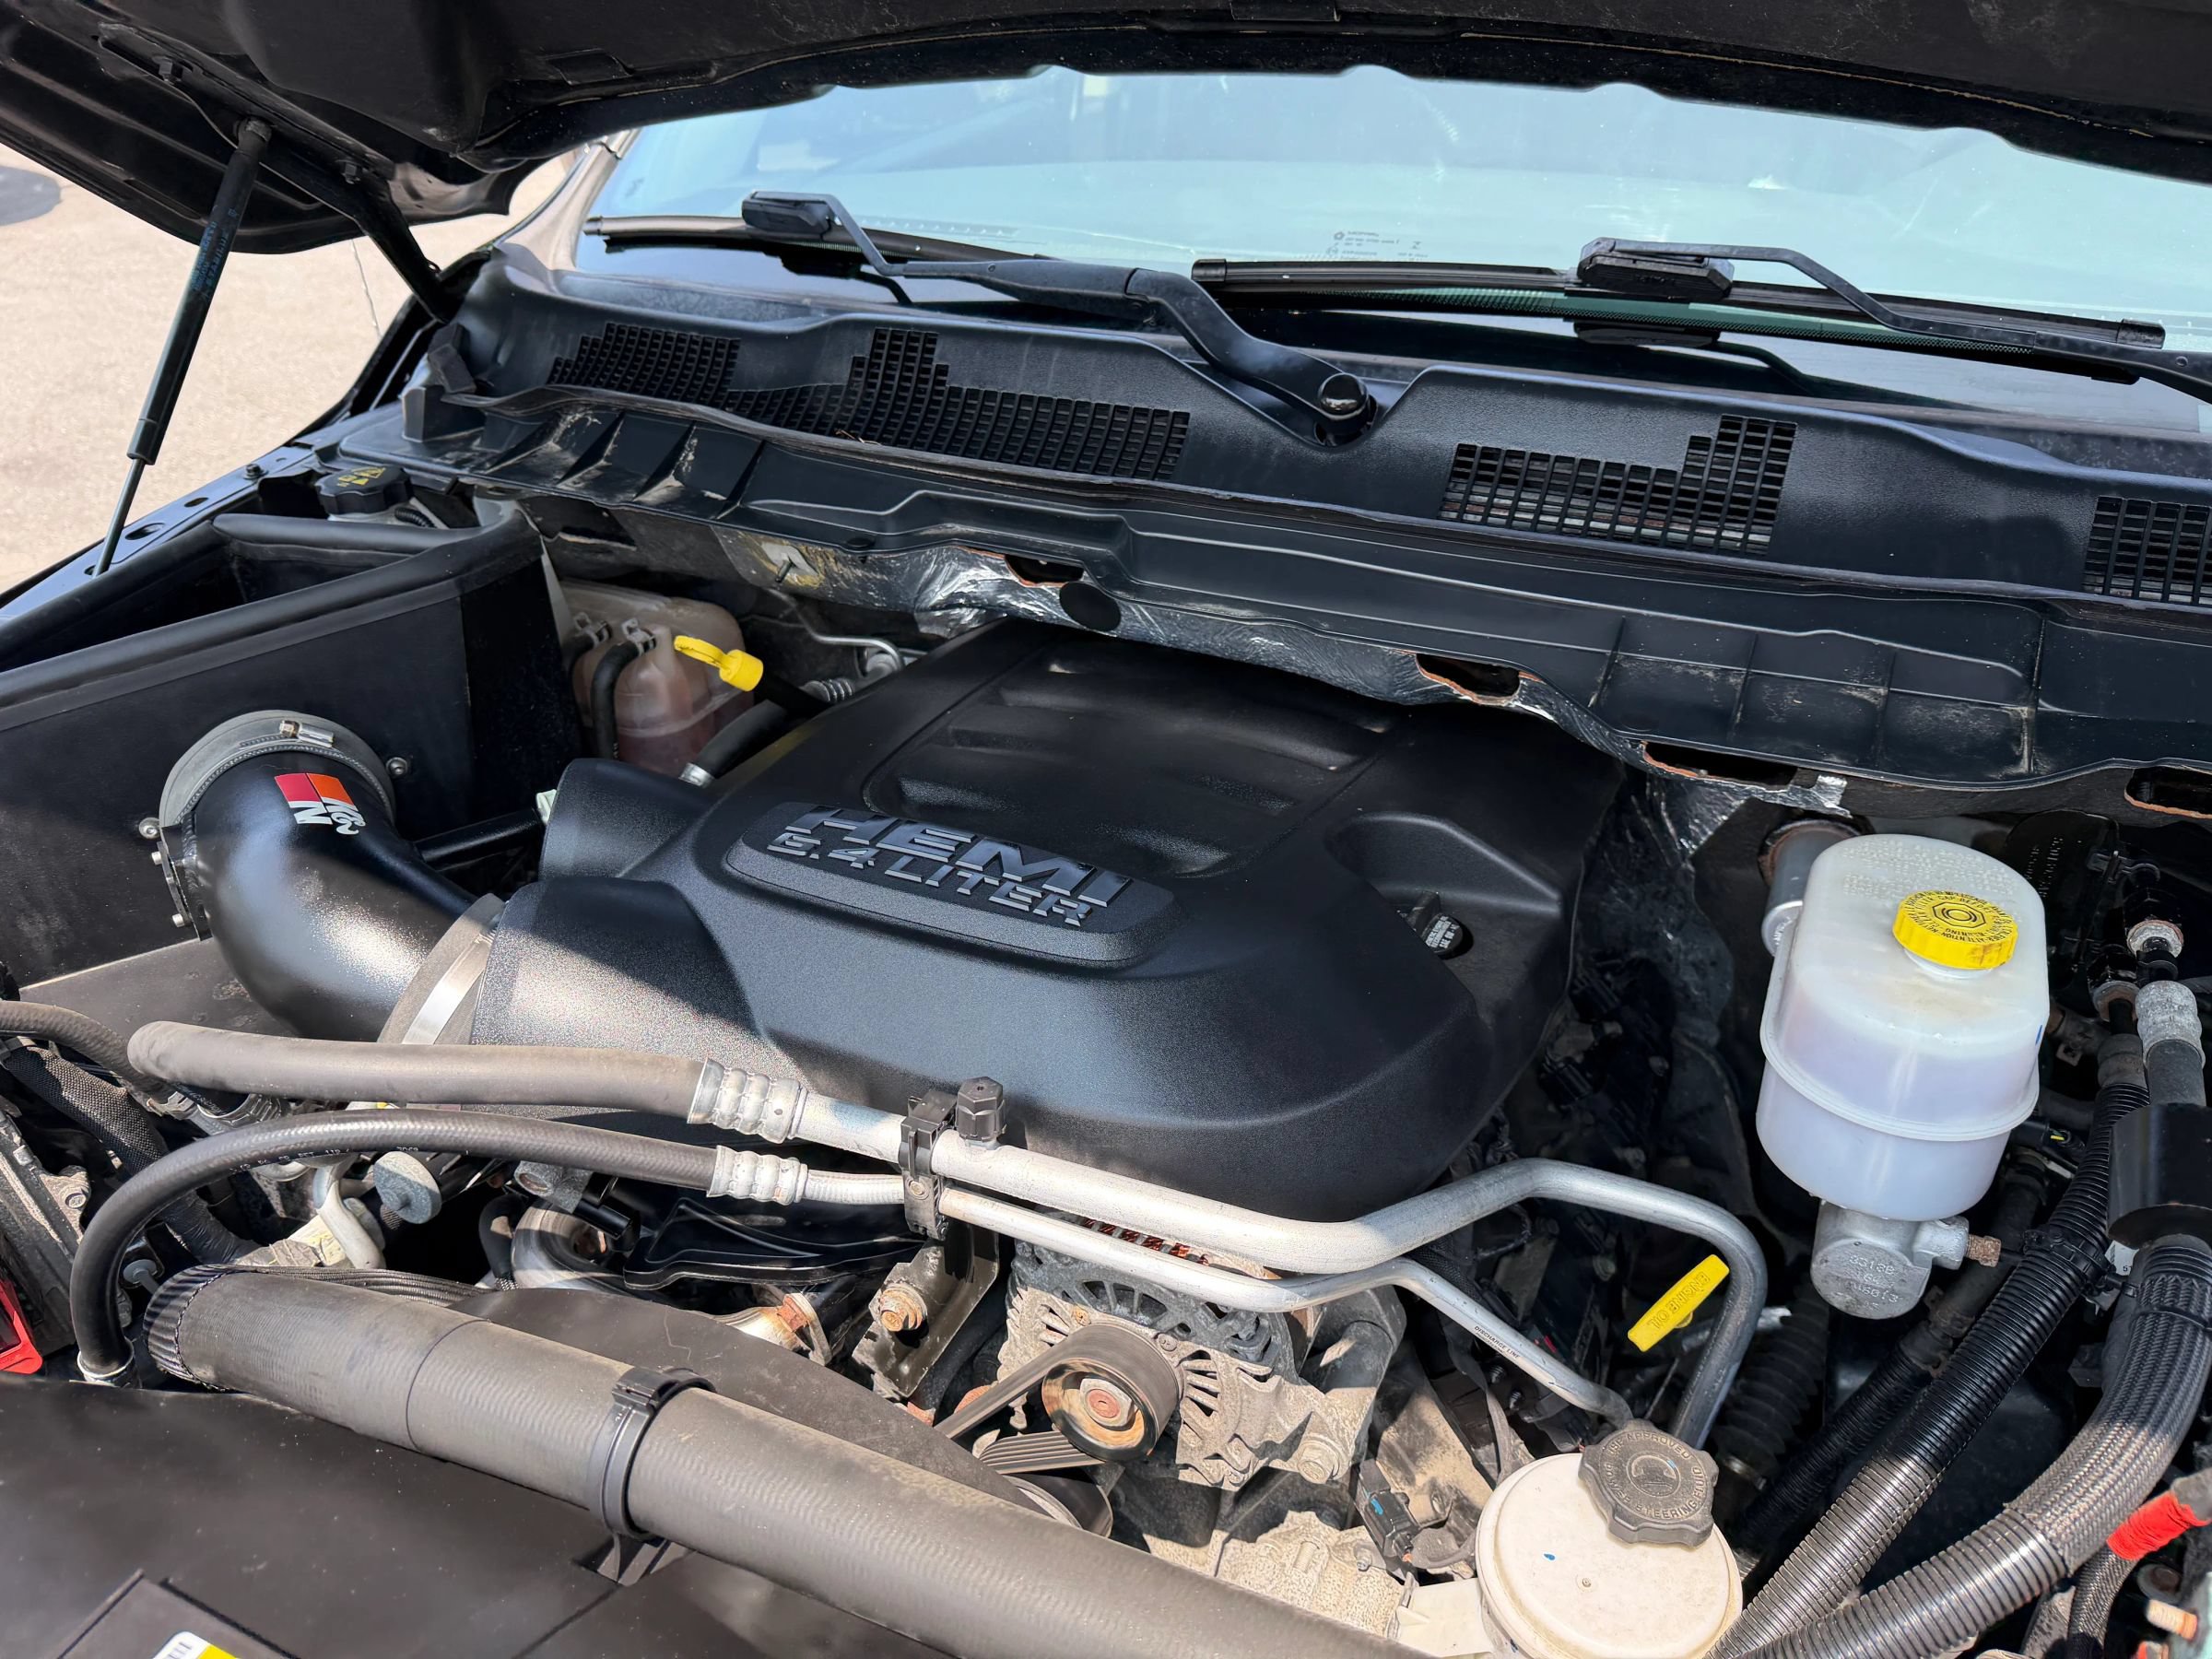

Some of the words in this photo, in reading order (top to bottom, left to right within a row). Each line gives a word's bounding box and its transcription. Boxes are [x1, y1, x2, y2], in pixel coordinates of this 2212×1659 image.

[288, 796, 366, 835] K&N
[784, 805, 1133, 908] HEMI
[766, 832, 875, 869] 6.4
[884, 854, 1093, 927] LITER
[1666, 1271, 1711, 1313] ENGINE
[1647, 1309, 1669, 1329] OIL
[1474, 1325, 1507, 1350] DISCHARGE
[1506, 1348, 1520, 1359] LINE
[1627, 1431, 1692, 1460] APPROVED
[1635, 1499, 1698, 1520] STEERING
